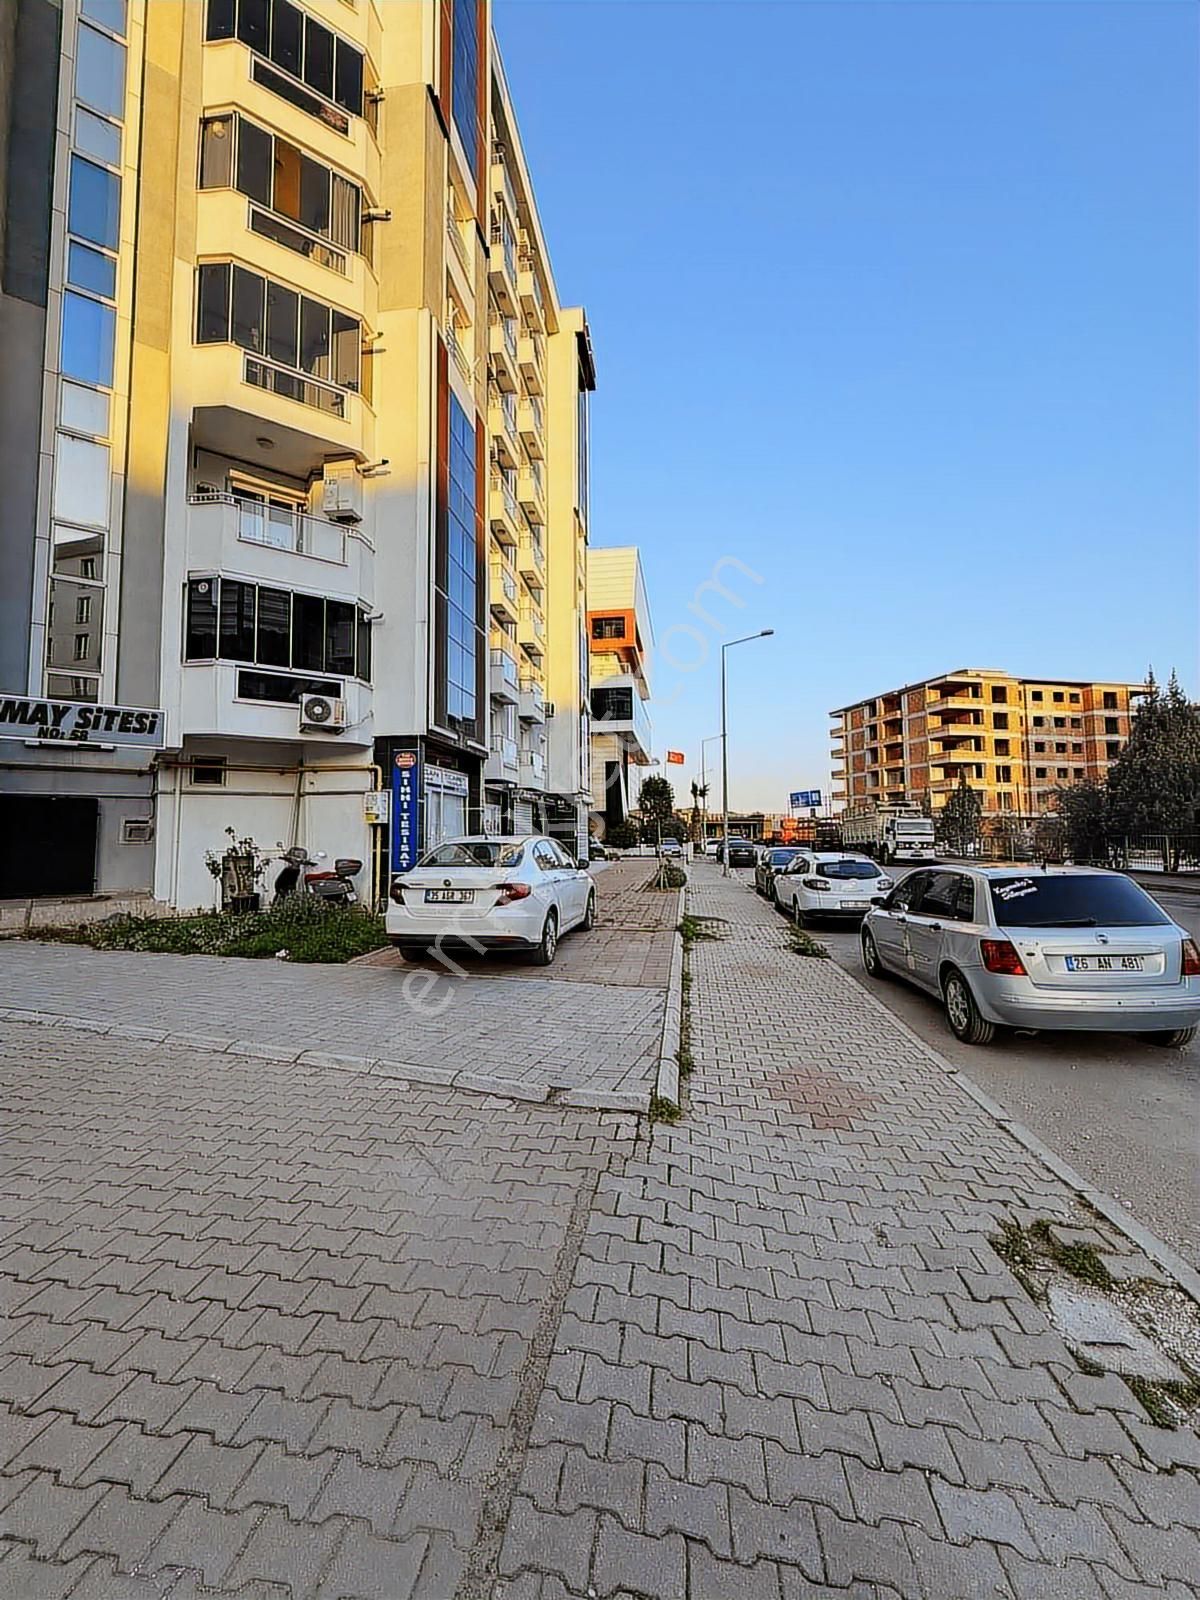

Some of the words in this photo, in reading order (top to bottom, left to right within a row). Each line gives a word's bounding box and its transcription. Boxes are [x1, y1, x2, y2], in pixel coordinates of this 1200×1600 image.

[0, 700, 72, 727] MAY
[1073, 957, 1089, 969] 26
[1097, 957, 1112, 969] AN
